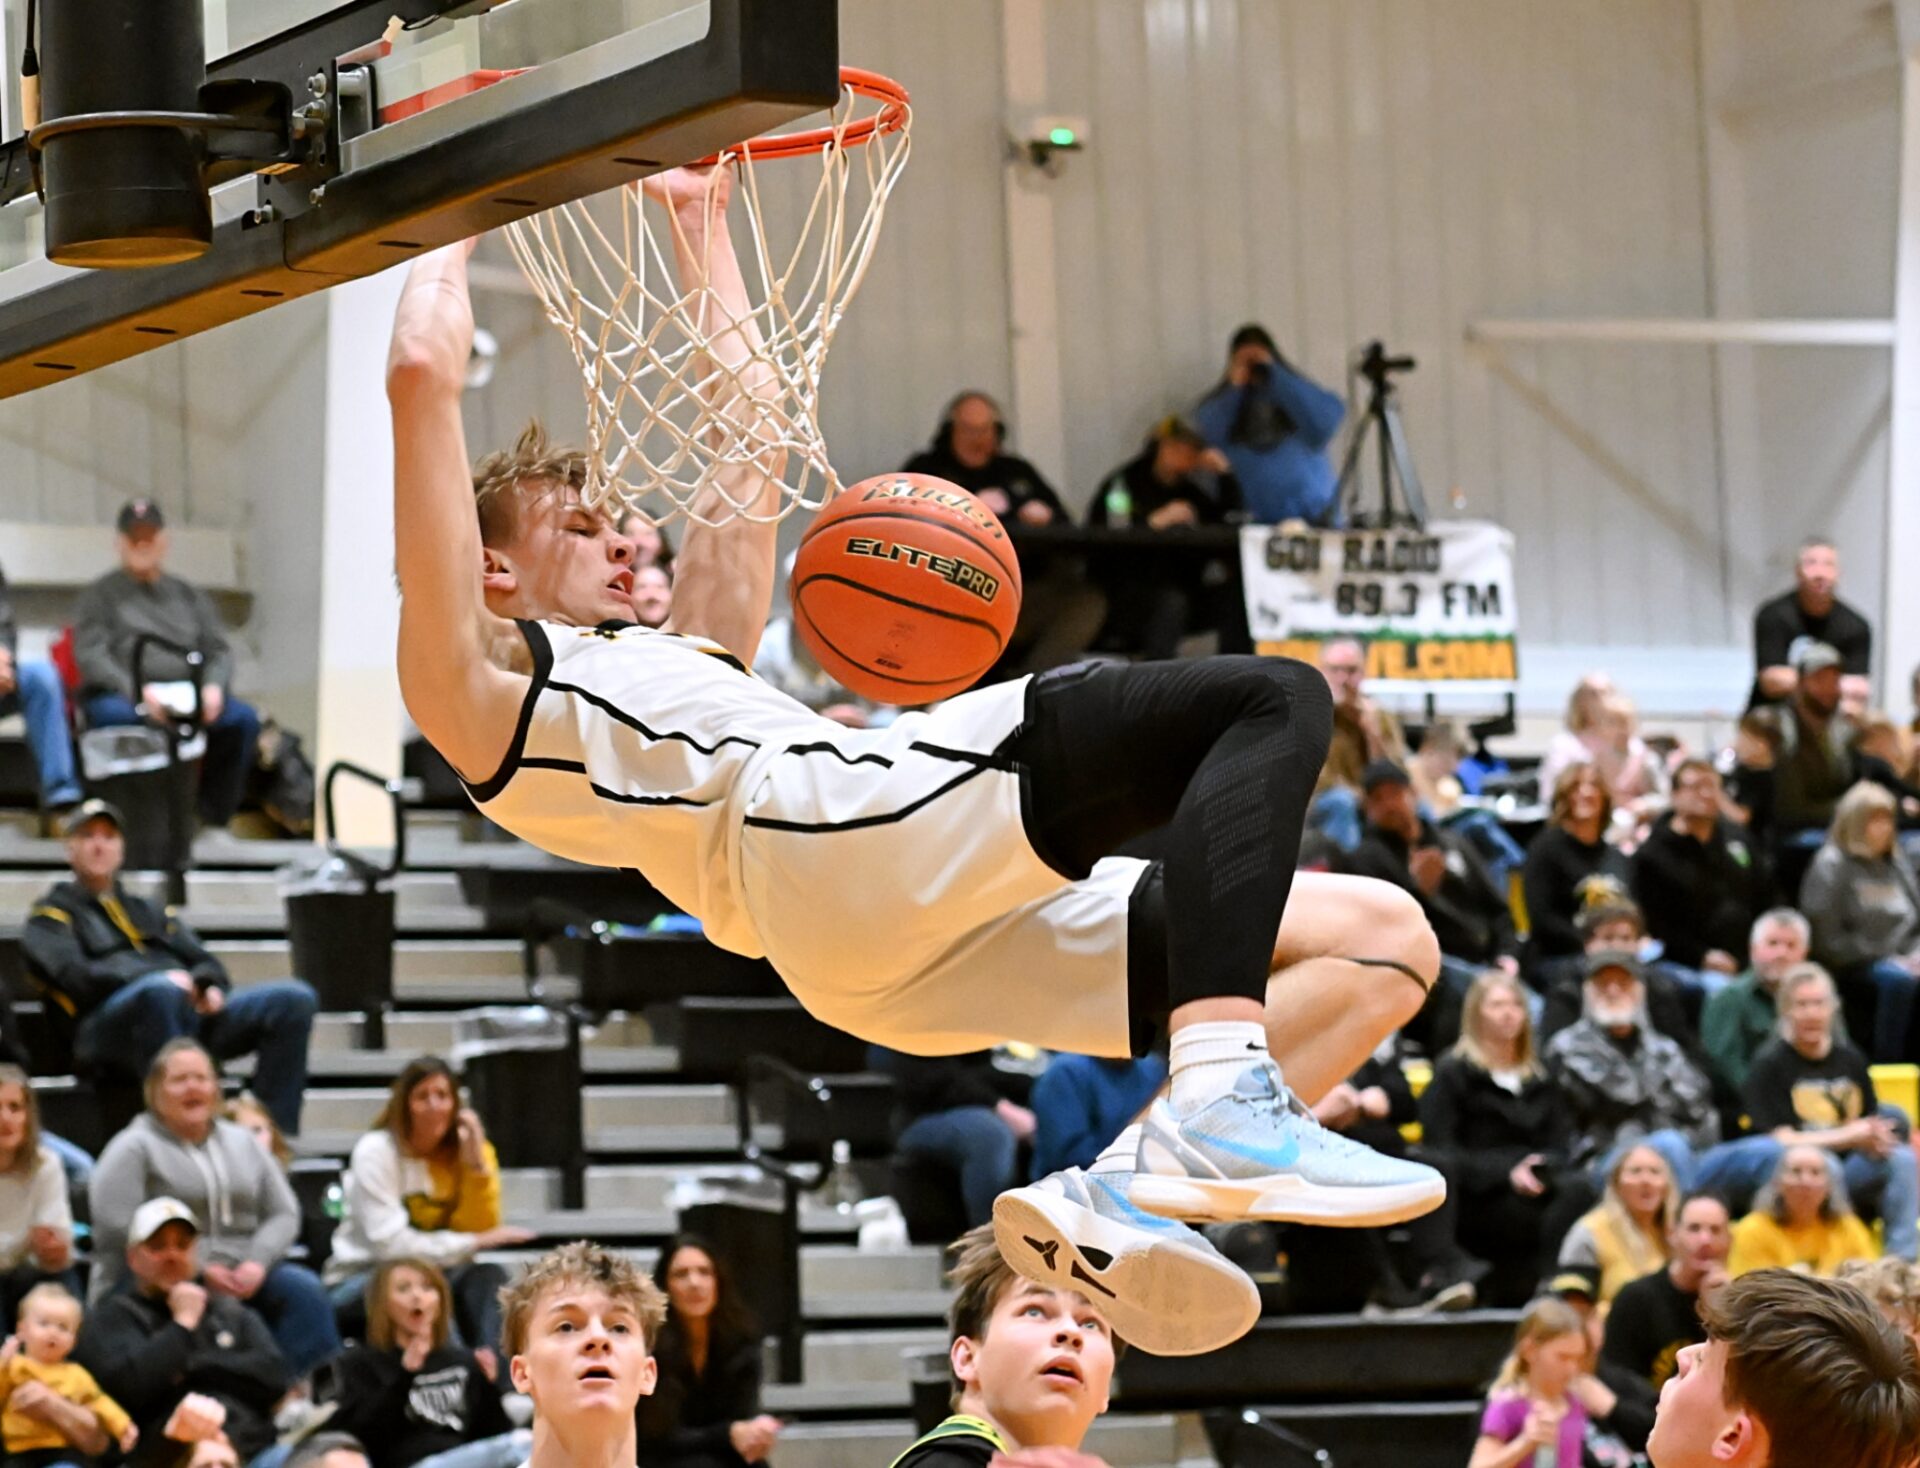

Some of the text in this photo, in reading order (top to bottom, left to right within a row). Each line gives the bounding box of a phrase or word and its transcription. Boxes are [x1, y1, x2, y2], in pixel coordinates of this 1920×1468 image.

[845, 536, 999, 600] ELITE PRO
[1343, 537, 1442, 573] RADIO
[1442, 582, 1502, 616] FM
